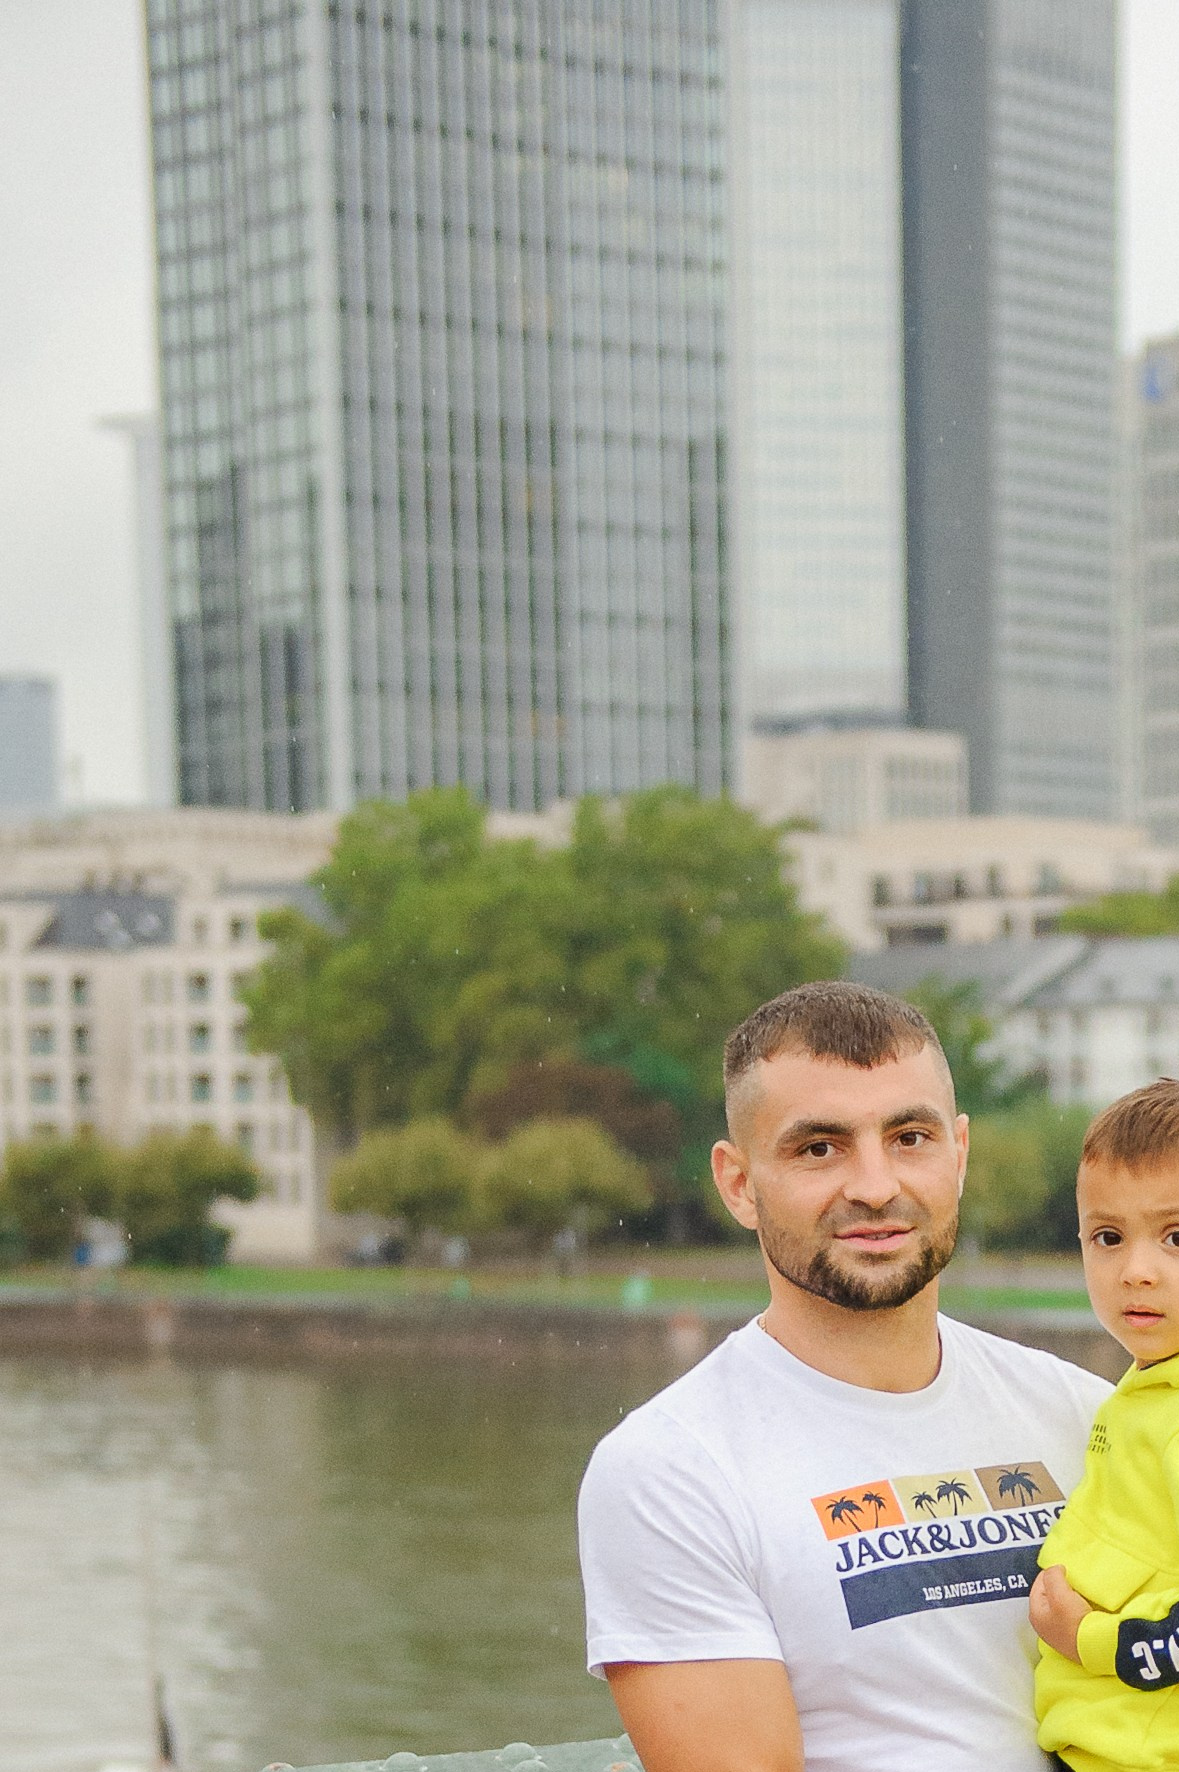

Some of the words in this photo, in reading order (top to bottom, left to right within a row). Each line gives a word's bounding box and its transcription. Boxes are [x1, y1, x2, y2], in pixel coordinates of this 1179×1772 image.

[922, 1585, 943, 1600] LOS
[943, 1577, 1007, 1599] ANGELES,
[1007, 1574, 1029, 1589] CA
